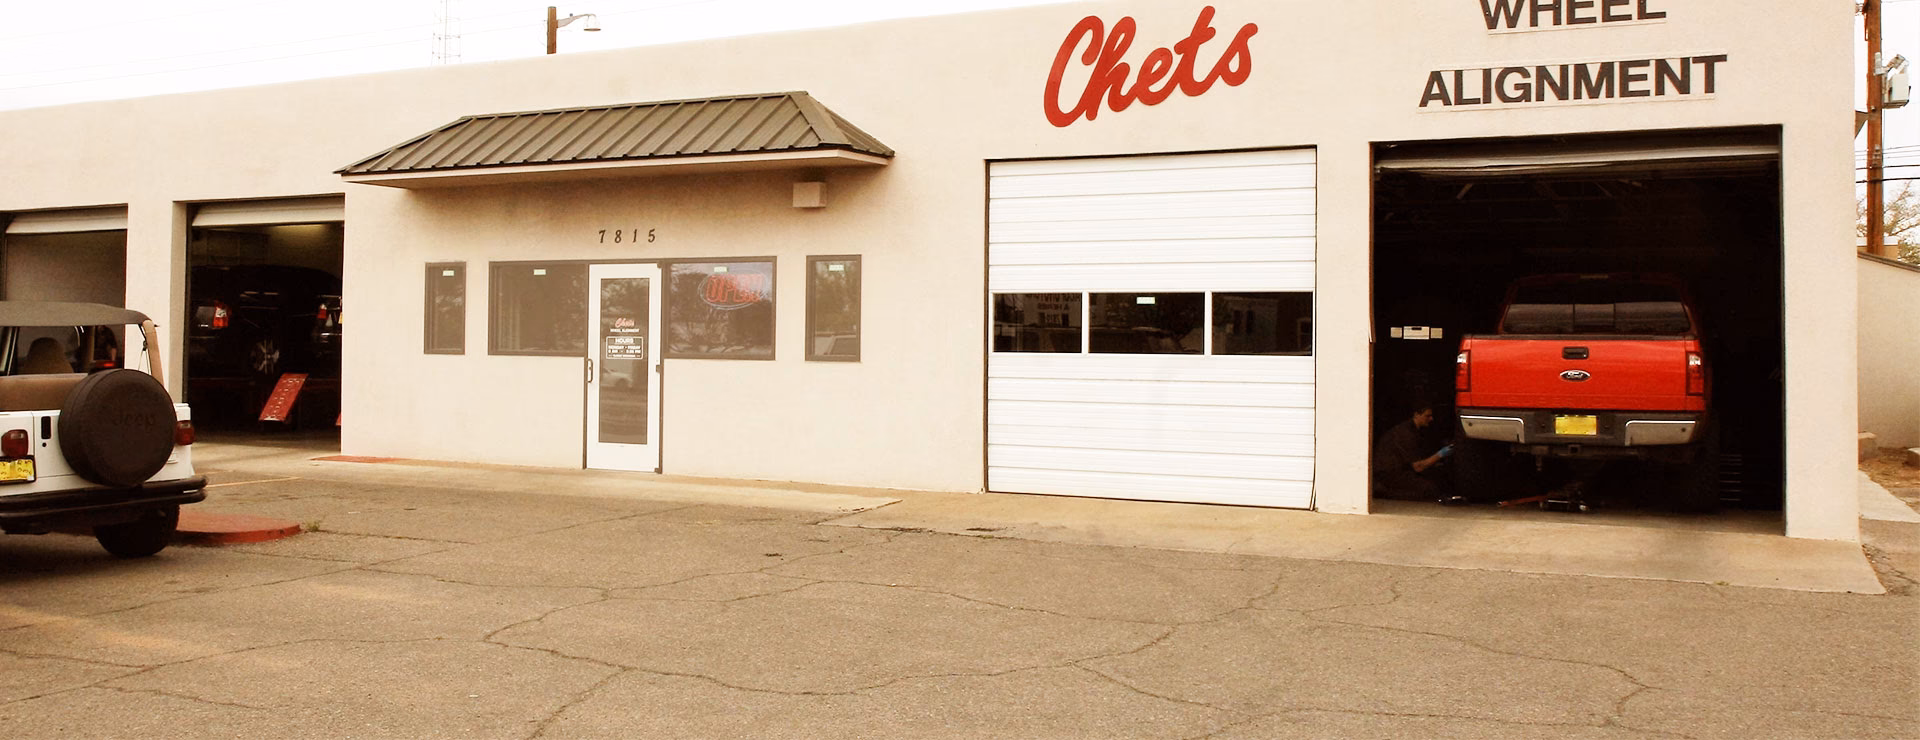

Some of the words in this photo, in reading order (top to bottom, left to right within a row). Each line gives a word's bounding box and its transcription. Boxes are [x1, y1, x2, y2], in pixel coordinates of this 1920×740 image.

[1480, 0, 1667, 30] WHEEL
[1044, 5, 1258, 128] Chets
[1418, 54, 1728, 108] ALIGNMENT
[598, 228, 656, 244] 7815
[706, 274, 762, 303] OPEN
